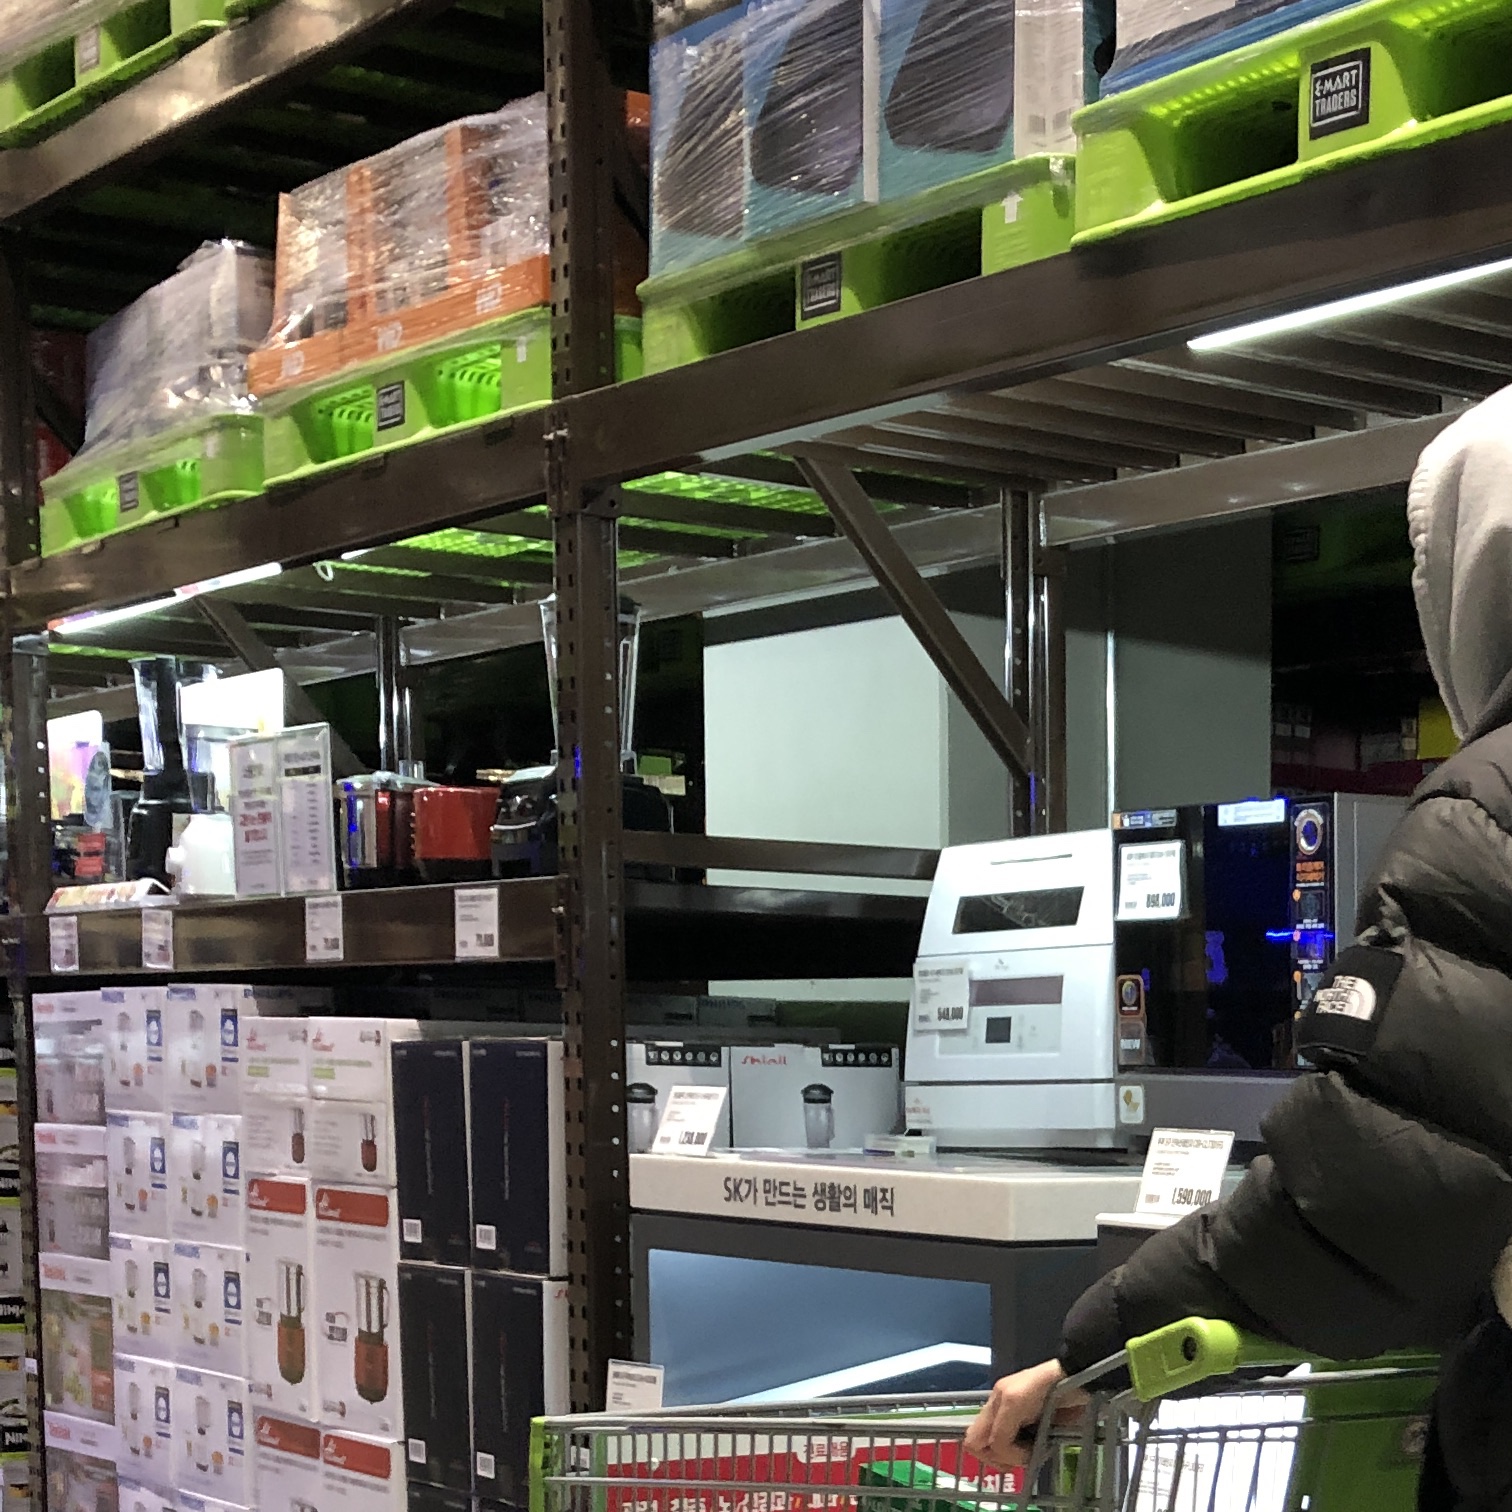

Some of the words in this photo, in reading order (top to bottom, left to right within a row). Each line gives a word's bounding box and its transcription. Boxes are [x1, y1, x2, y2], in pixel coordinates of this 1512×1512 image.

[1314, 88, 1357, 117] TRADERS
[723, 1175, 759, 1205] SK가
[762, 1178, 807, 1211] 만드는
[811, 1181, 858, 1214] 생활의
[863, 1185, 896, 1217] 매직
